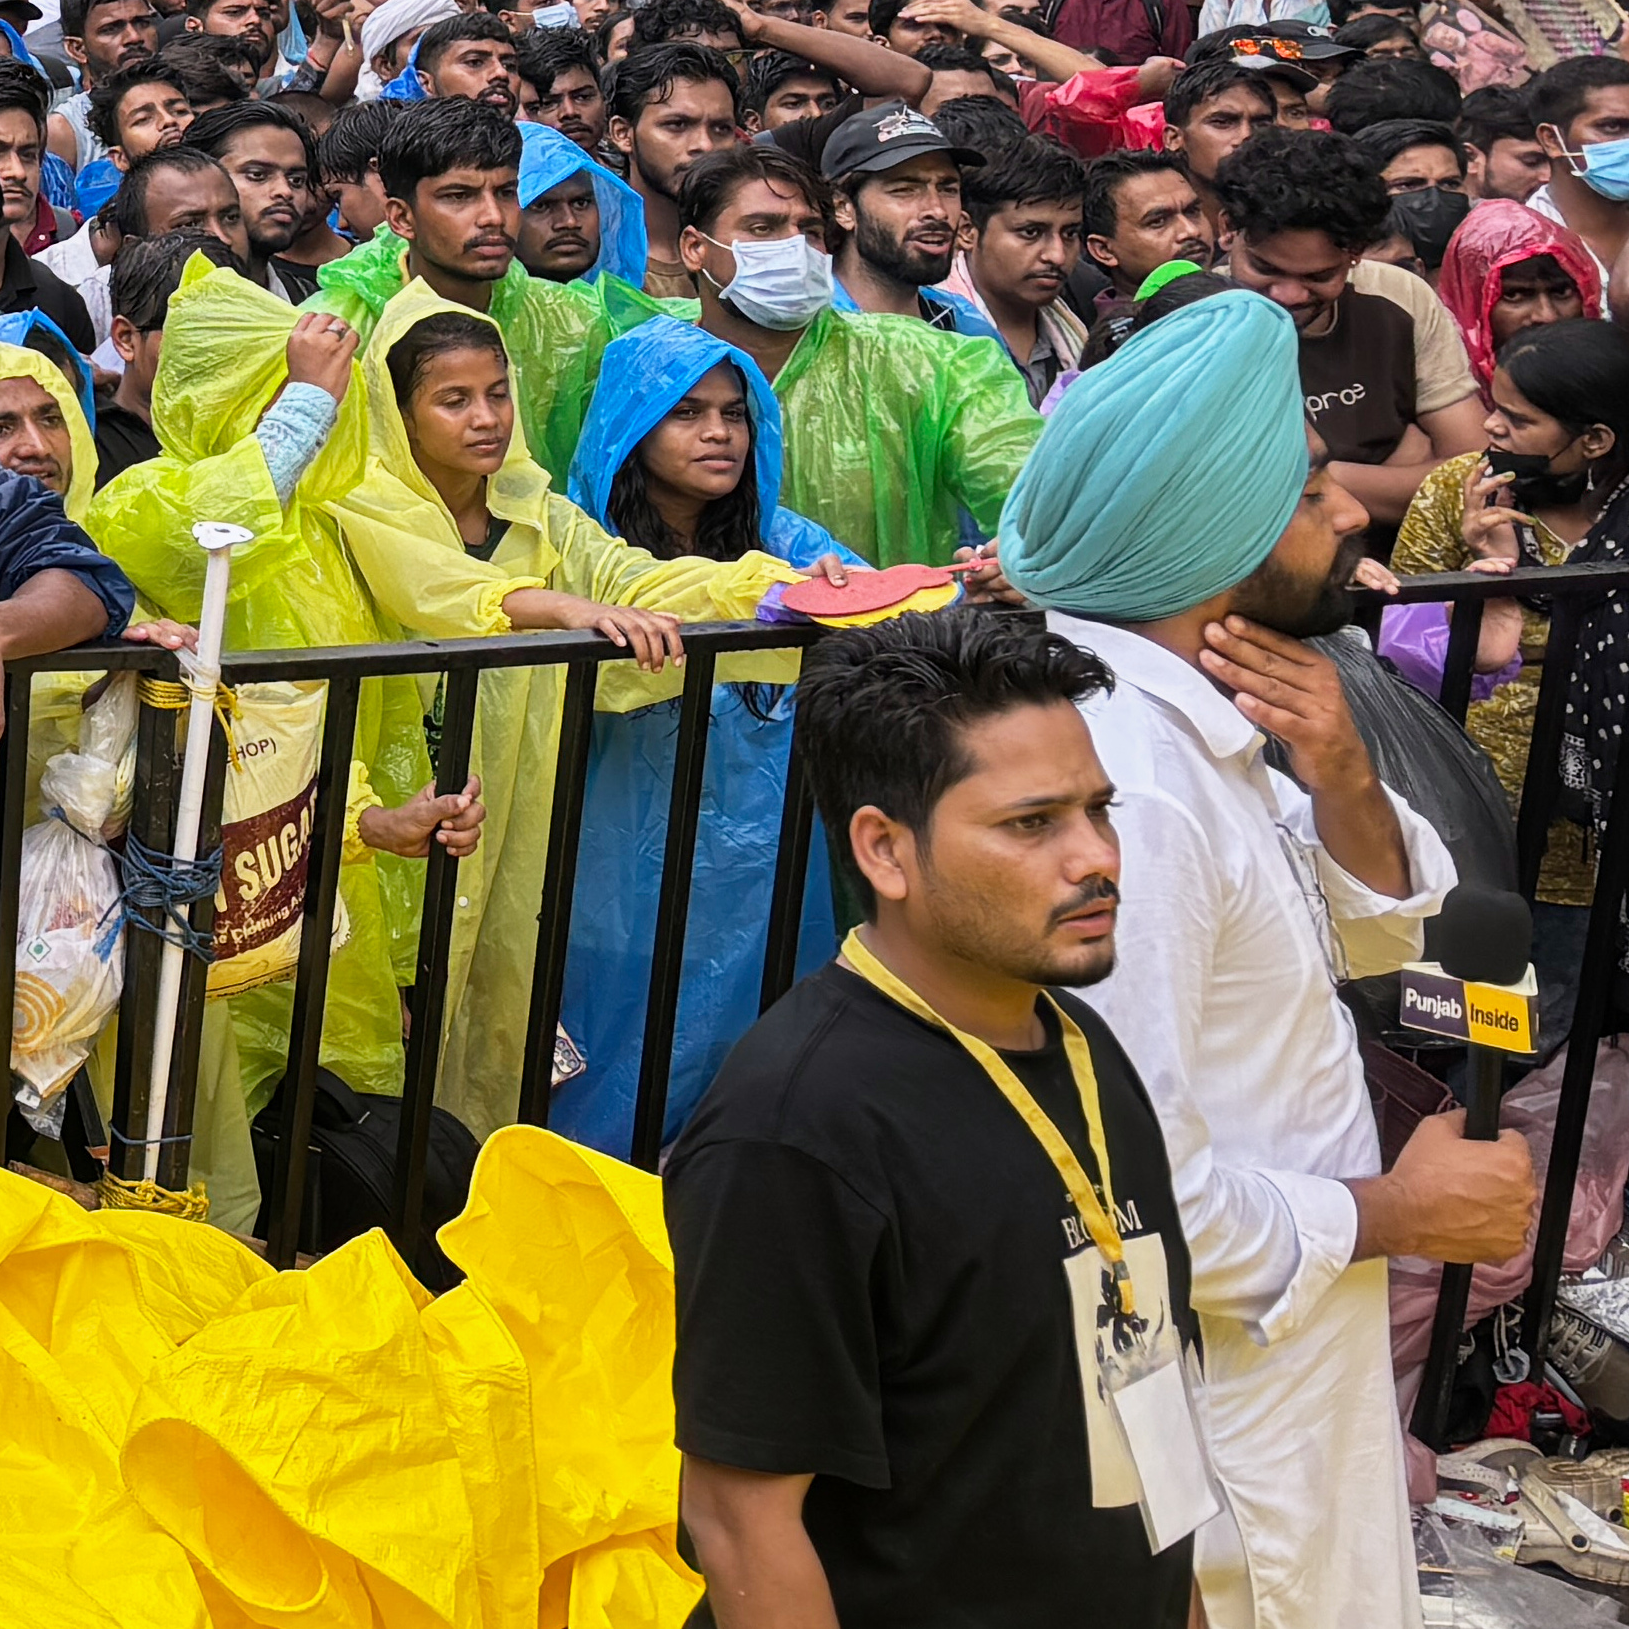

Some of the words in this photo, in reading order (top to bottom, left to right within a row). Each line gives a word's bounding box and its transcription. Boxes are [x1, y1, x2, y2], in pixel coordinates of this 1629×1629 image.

[226, 737, 276, 765] HOP)
[1405, 987, 1462, 1019] Punjab
[1470, 1002, 1519, 1032] Inside
